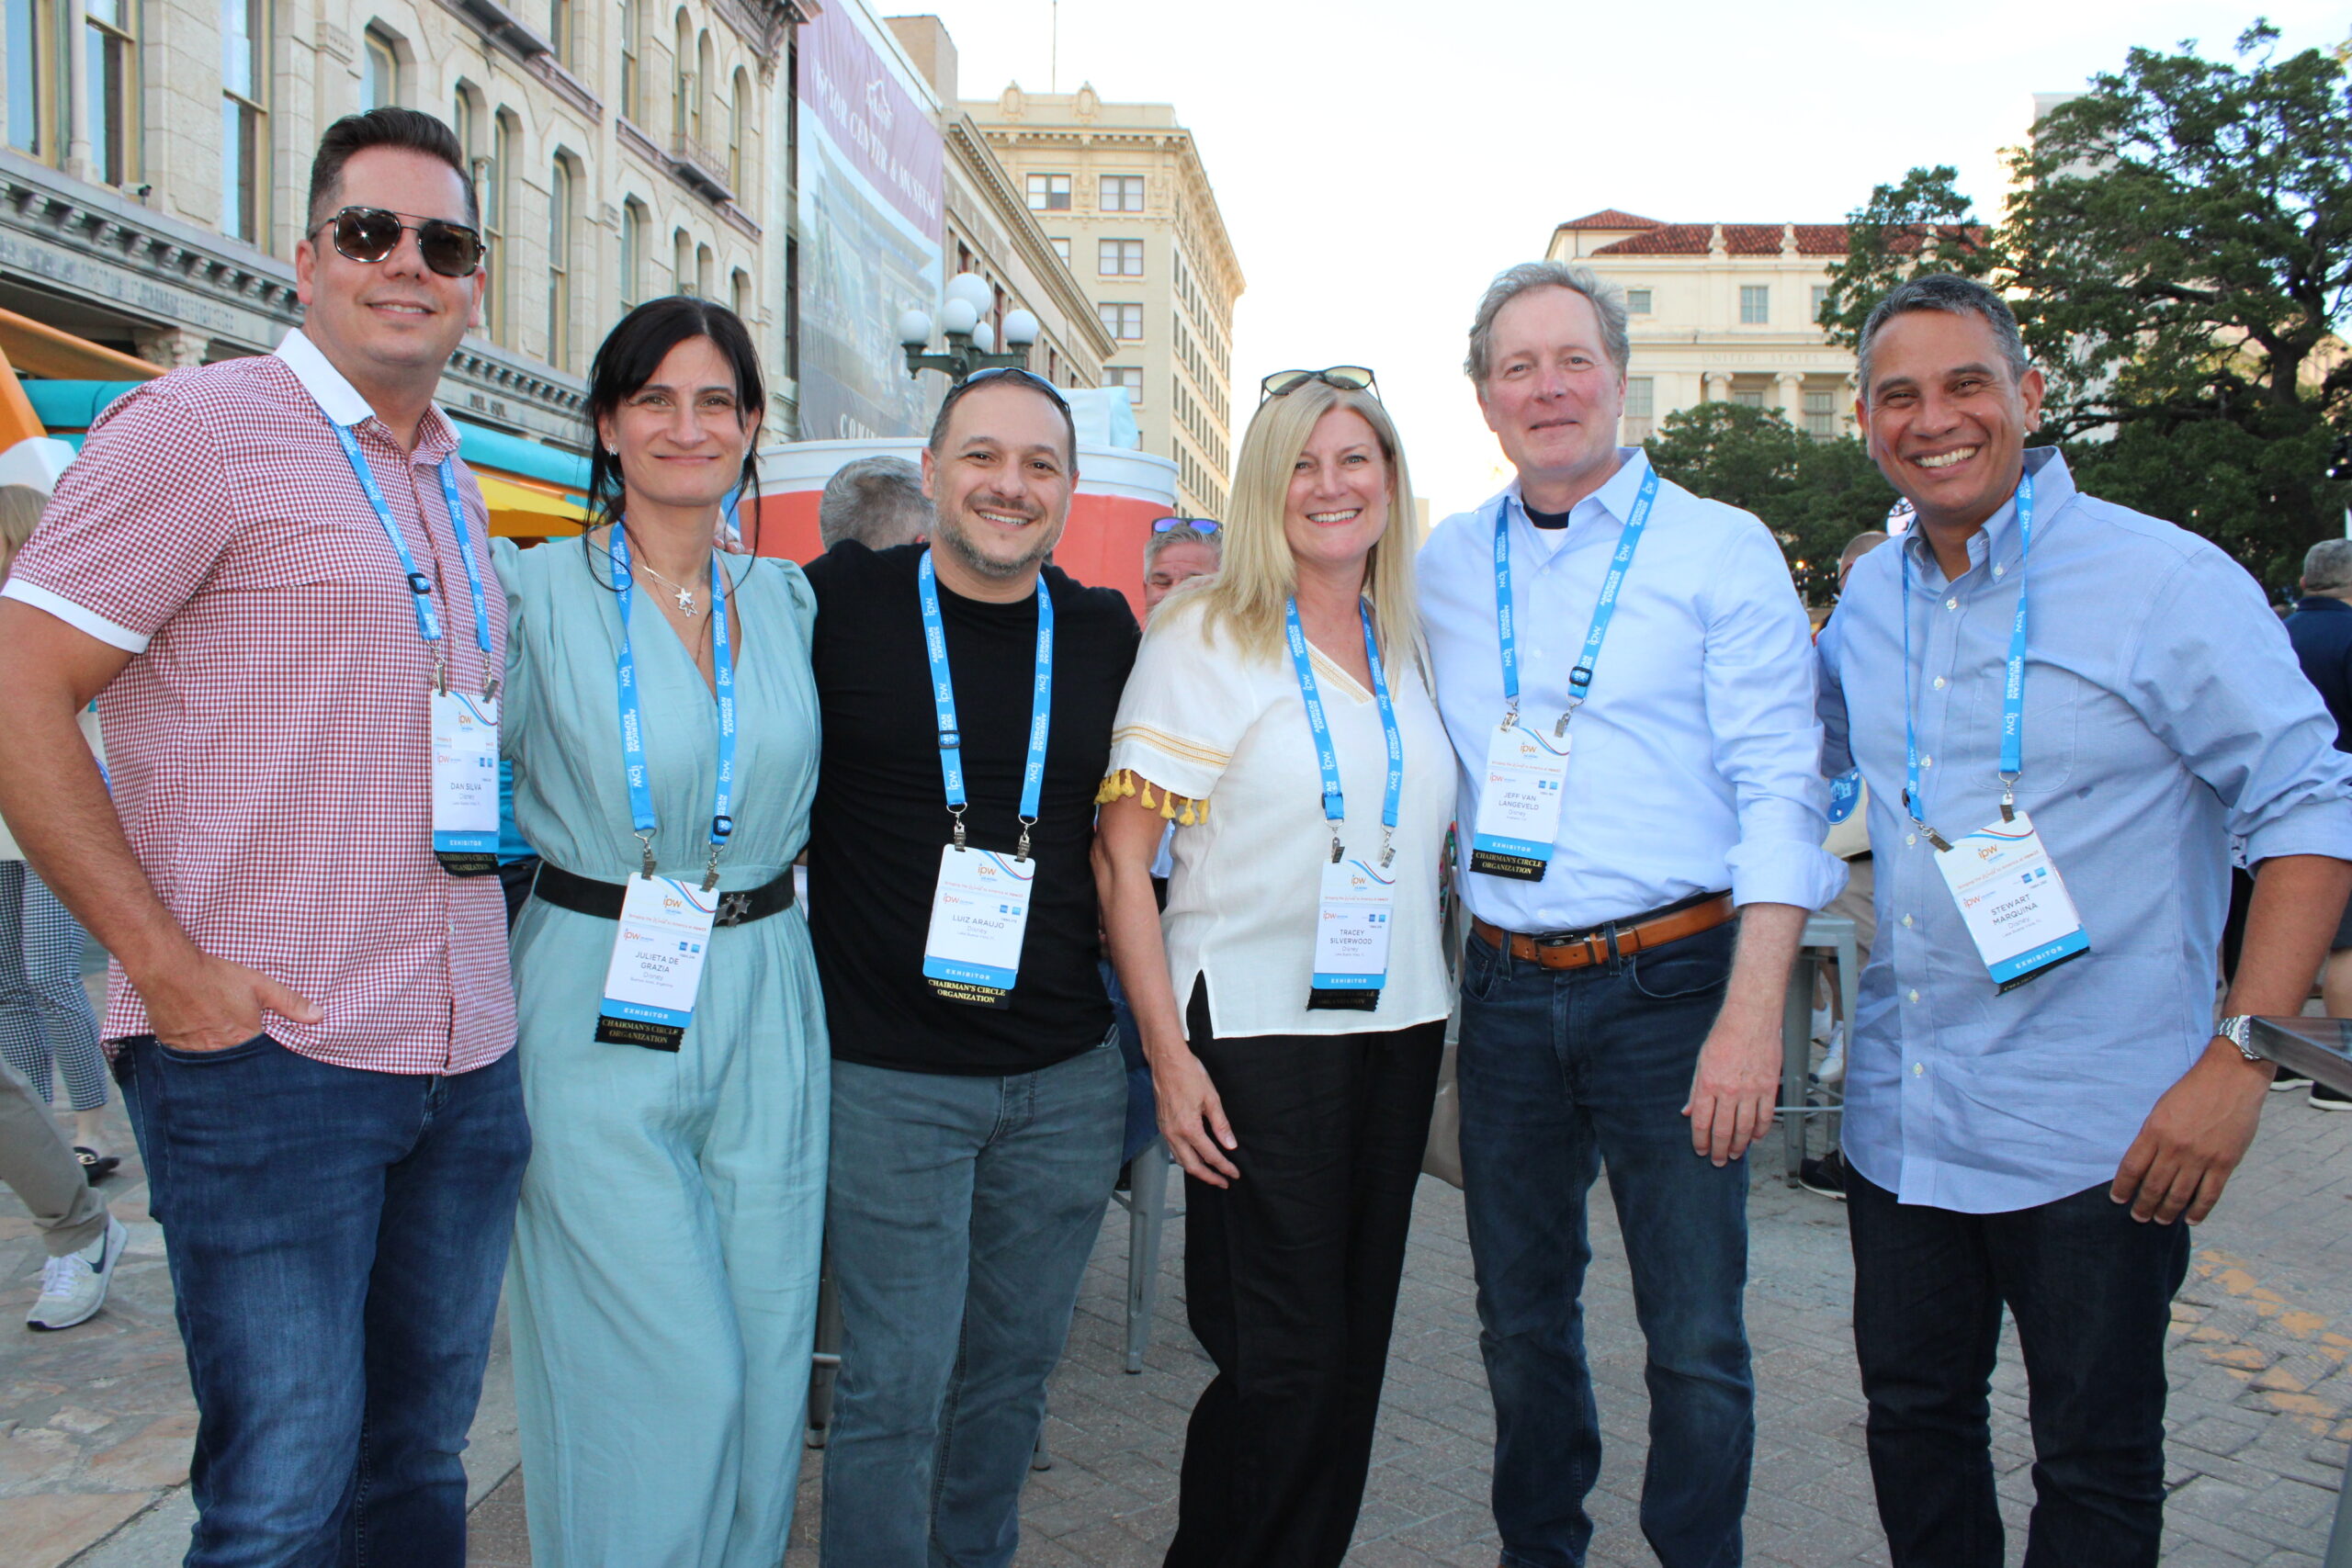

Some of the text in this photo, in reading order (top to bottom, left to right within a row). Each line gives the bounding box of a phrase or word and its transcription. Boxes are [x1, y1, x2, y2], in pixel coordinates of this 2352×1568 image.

[810, 51, 848, 130] VISITOR
[850, 111, 888, 174] CENTER
[889, 155, 898, 183] &
[899, 164, 936, 220] MUSEUM
[1702, 352, 1755, 364] UNITED
[1770, 352, 1820, 364] STATES
[1629, 499, 1644, 528] AMERICAN
[1634, 501, 1649, 526] EXPRESS
[1613, 543, 1631, 563] ipw
[1497, 570, 1509, 588] ipw
[1600, 570, 1616, 607] AMERICAN
[1606, 570, 1623, 604] EXPRESS
[924, 597, 938, 616] ipw
[712, 609, 723, 648] AMERICAN
[718, 612, 728, 645] EXPRESS
[2015, 610, 2026, 633] ipw
[928, 626, 939, 664] AMERICAN
[934, 626, 944, 660] EXPRESS
[1287, 625, 1301, 659] AMERICAN
[1293, 624, 1305, 655] EXPRESS
[1587, 625, 1602, 646] ipw
[1502, 647, 1514, 667] ipw
[618, 664, 633, 687] ipw
[718, 666, 733, 687] ipw
[1036, 672, 1050, 694] ipw
[1302, 673, 1316, 692] ipw
[2006, 660, 2015, 699] EXPRESS
[2013, 655, 2022, 699] AMERICAN
[937, 682, 951, 703] ipw
[719, 696, 729, 738] AMERICAN
[726, 697, 735, 733] EXPRESS
[1307, 700, 1320, 734] AMERICAN
[1312, 700, 1325, 730] EXPRESS
[2003, 712, 2019, 736] ipw
[623, 714, 632, 753] EXPRESS
[628, 707, 641, 752] AMERICAN
[1032, 716, 1042, 750] EXPRESS
[1037, 712, 1047, 752] AMERICAN
[1521, 742, 1538, 754] ipw
[1321, 750, 1336, 771] ipw
[628, 764, 644, 788] ipw
[719, 760, 732, 783] ipw
[946, 770, 962, 791] ipw
[1028, 761, 1042, 784] ipw
[1388, 770, 1402, 792] ipw
[450, 782, 482, 791] DAN SILVA
[1498, 800, 1540, 810] LANGEVELD
[1521, 794, 1537, 802] VAN
[1491, 841, 1532, 852] EXHIBITOR
[1976, 843, 1998, 861] ipw
[977, 863, 997, 876] ipw
[1476, 852, 1543, 868] CHAIRMAN'S CIRCLE
[1482, 861, 1532, 874] ORGANIZATION
[1351, 874, 1366, 886] ipw
[662, 894, 683, 908] ipw
[943, 892, 960, 904] ipw
[1962, 896, 1982, 909] ipw
[1990, 893, 2030, 917] STEWART
[952, 915, 971, 924] LUIZ
[972, 918, 1005, 930] ARAUJO
[1992, 901, 2039, 926] MARQUINA
[624, 928, 641, 942] ipw
[635, 951, 667, 963] JULIETA
[668, 956, 680, 965] DE
[640, 962, 671, 973] GRAZIA
[2014, 944, 2064, 970] EXHIBITOR
[945, 968, 991, 981] EXHIBITOR
[928, 979, 1006, 997] CHAIRMAN'S CIRCLE
[936, 988, 996, 1004] ORGANIZATION
[624, 1007, 669, 1020] EXHIBITOR
[602, 1019, 679, 1035] CHAIRMAN'S CIRCLE
[609, 1030, 668, 1043] ORGANIZATION
